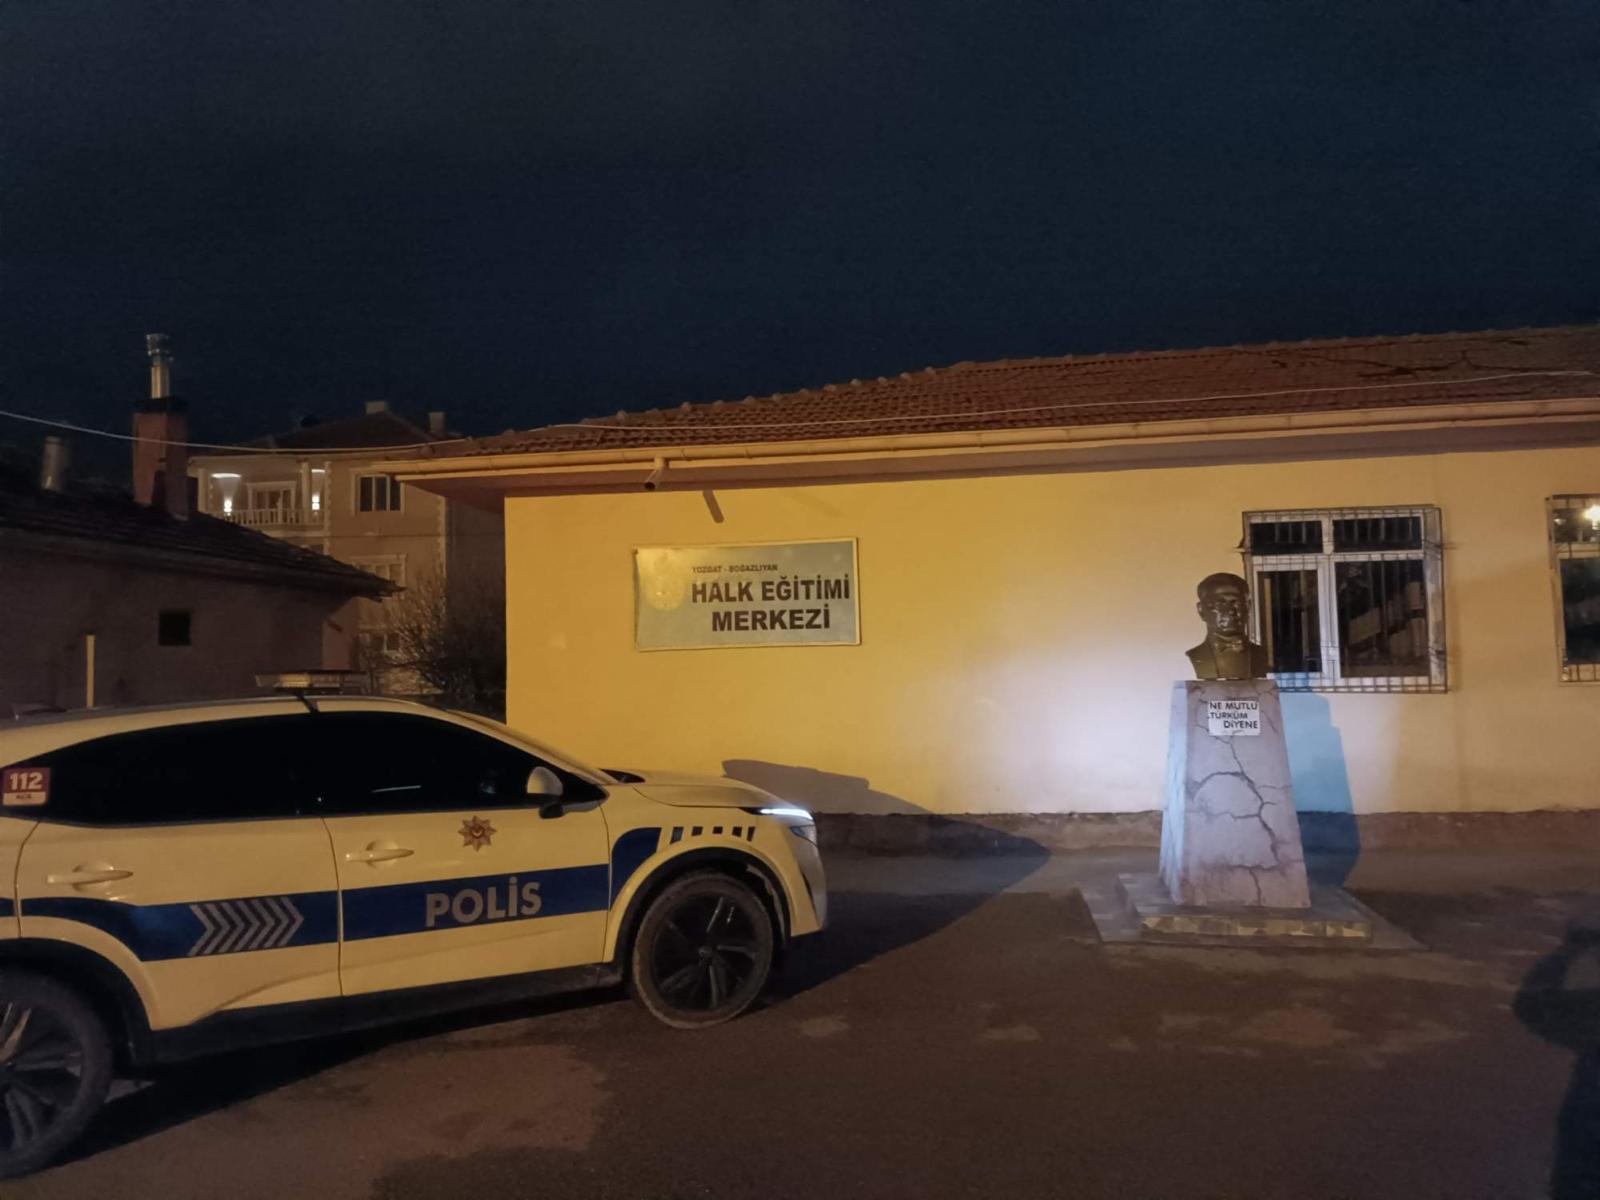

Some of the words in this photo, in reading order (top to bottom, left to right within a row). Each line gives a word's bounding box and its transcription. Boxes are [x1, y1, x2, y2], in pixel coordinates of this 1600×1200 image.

[692, 581, 754, 603] HALK
[761, 574, 850, 601] EĞİTİMİ
[712, 604, 830, 631] MERKEZİ
[1210, 702, 1221, 710] NE
[1225, 702, 1257, 710] MUTLU
[10, 771, 43, 790] 112
[425, 876, 542, 927] POLİS
